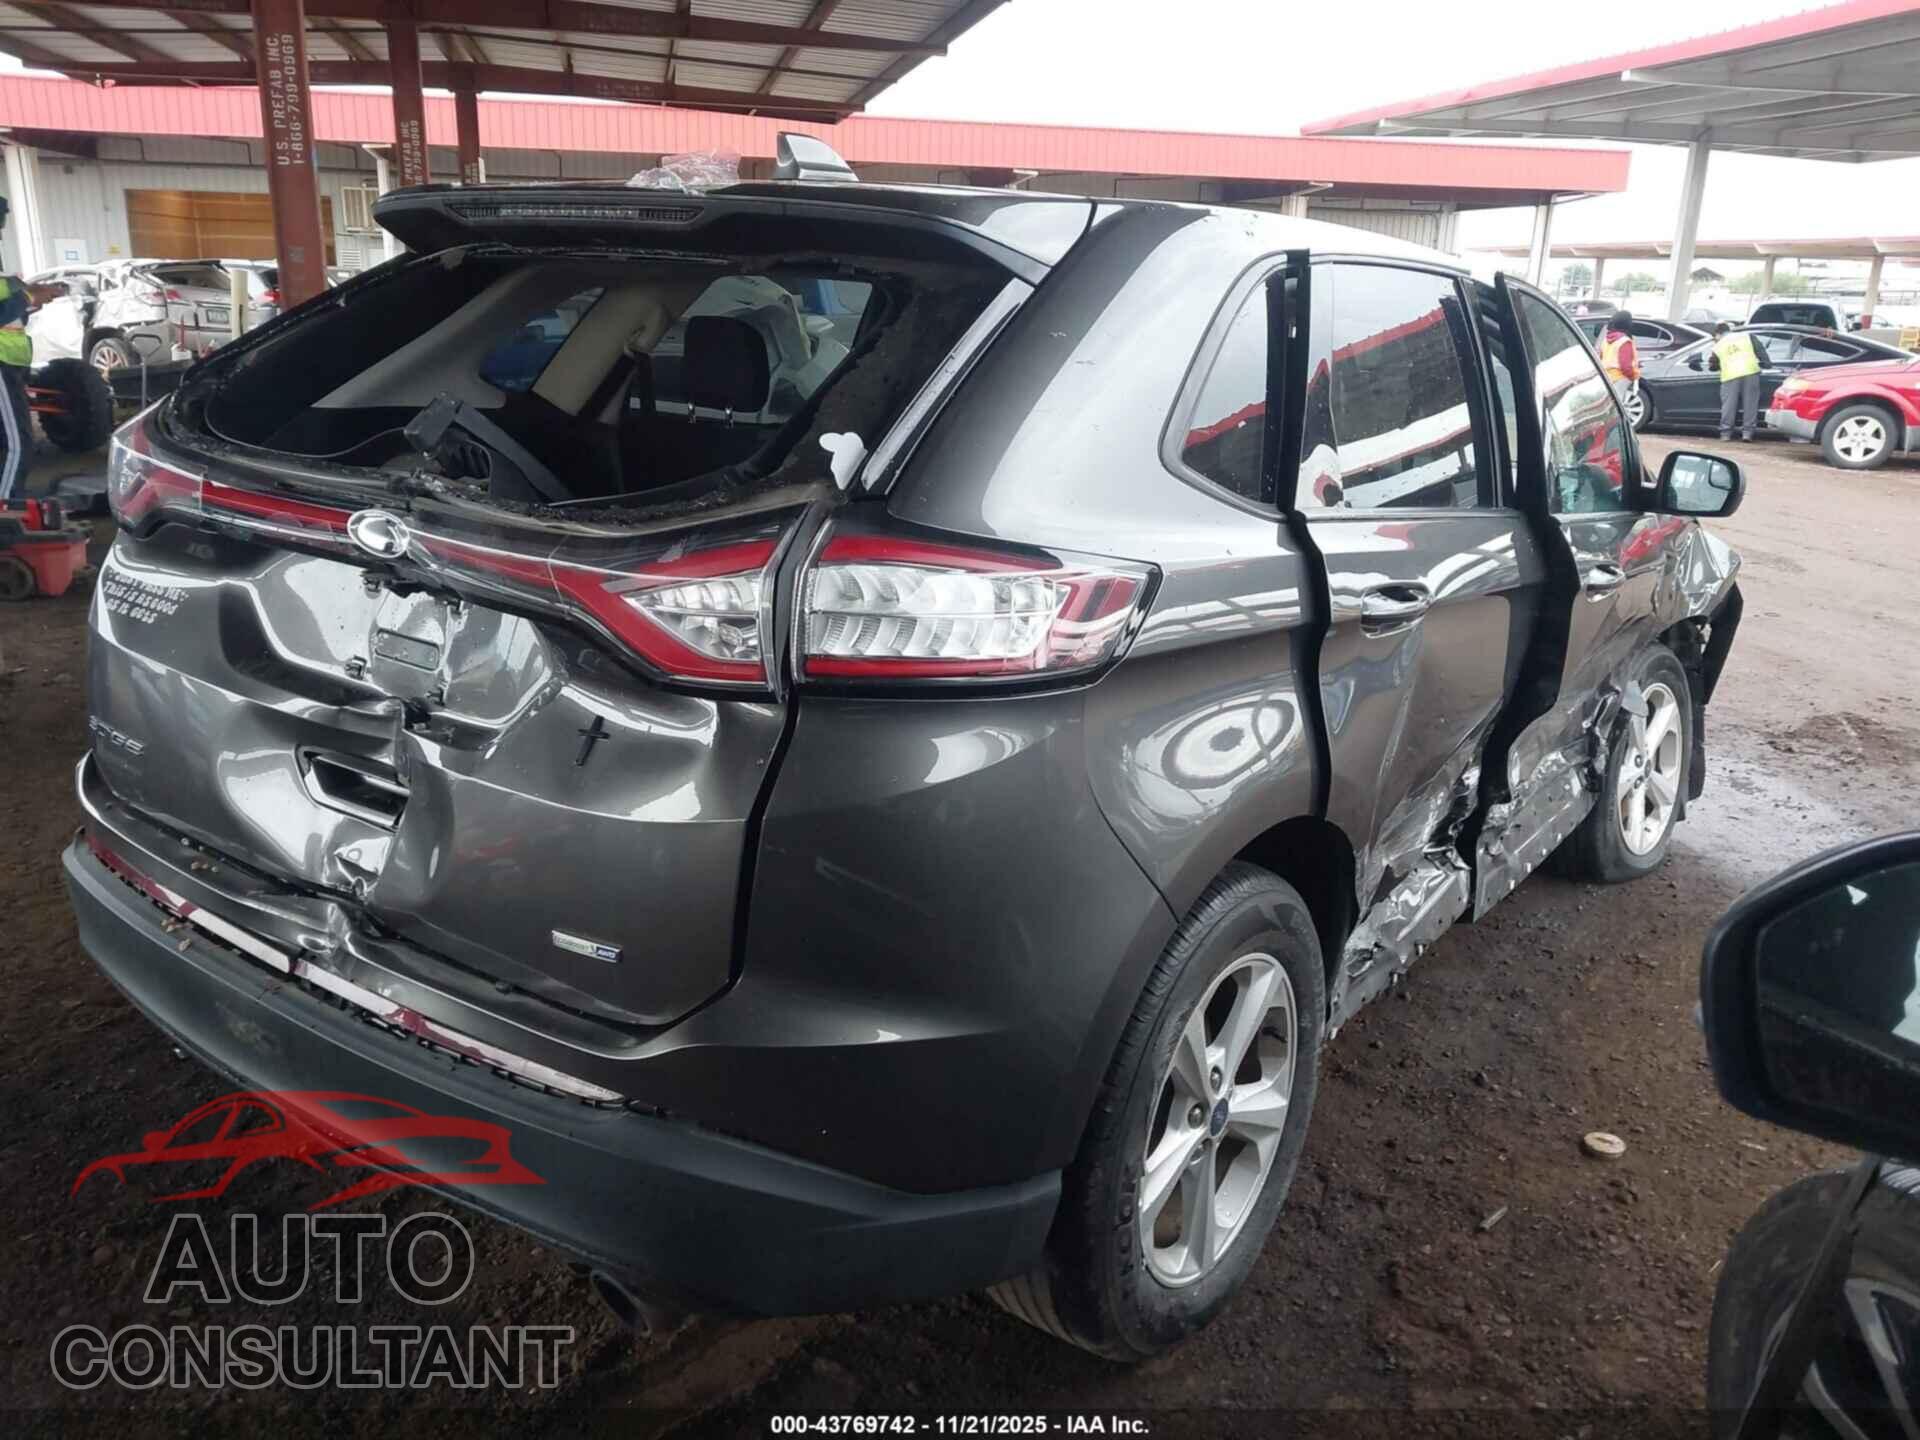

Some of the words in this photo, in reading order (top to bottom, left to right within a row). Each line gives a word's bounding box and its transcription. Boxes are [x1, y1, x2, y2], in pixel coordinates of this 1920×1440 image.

[270, 69, 287, 129] PREFAB
[281, 34, 305, 165] 1-866-799-0969
[275, 138, 291, 166] U.S.
